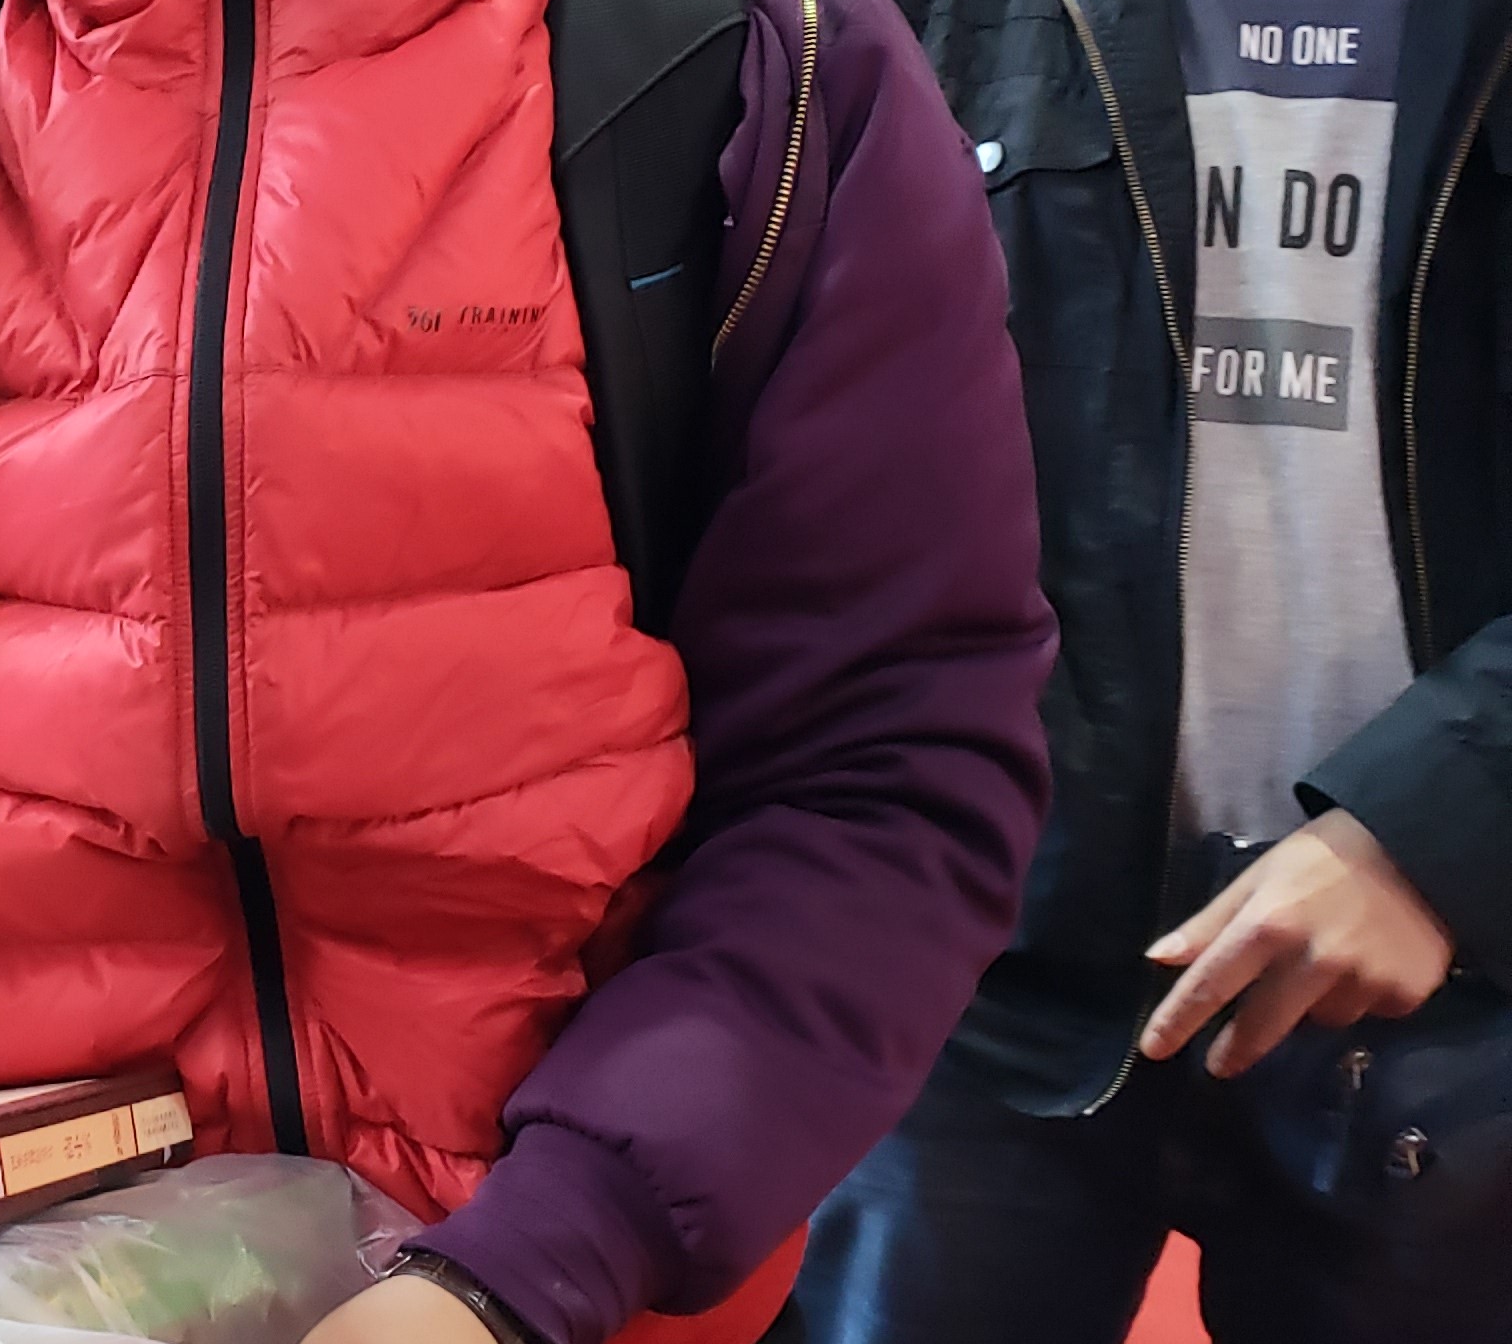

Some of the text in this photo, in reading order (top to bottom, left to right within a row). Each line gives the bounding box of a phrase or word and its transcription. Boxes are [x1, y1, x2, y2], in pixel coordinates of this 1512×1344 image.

[1239, 23, 1361, 66] NO ONE
[1279, 168, 1362, 257] DO
[1192, 346, 1339, 404] FOR ME
